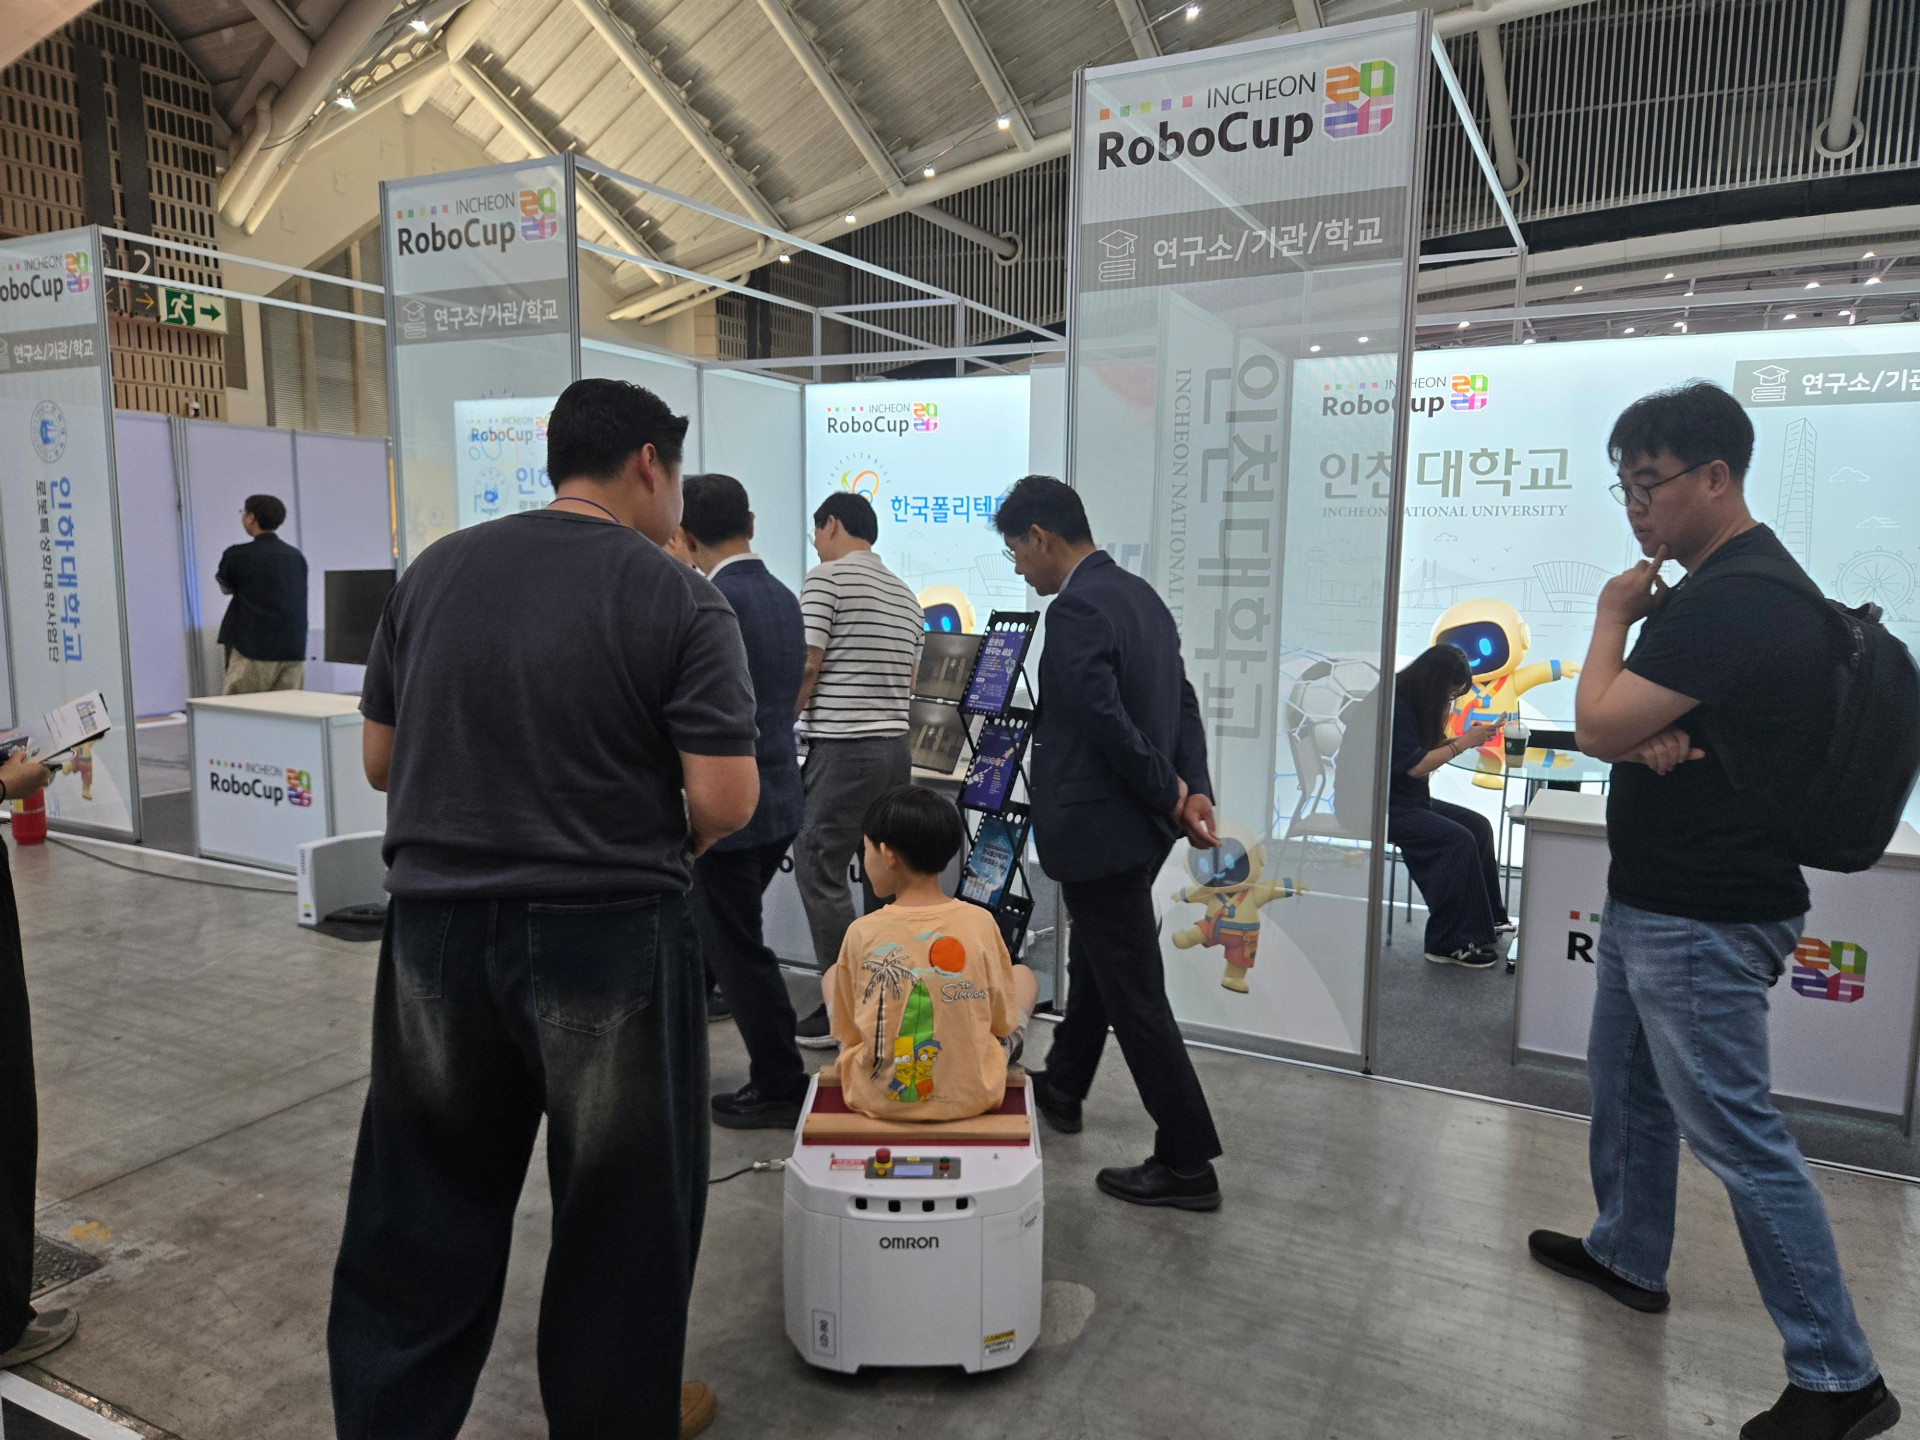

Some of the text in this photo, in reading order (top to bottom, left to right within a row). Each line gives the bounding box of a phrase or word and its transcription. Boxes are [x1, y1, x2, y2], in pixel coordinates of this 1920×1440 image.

[1207, 71, 1316, 109] INCHEON
[1098, 110, 1314, 171] RoboCup
[456, 192, 515, 215] INCHEON
[398, 218, 516, 256] RoboCup
[1153, 216, 1383, 270] 연구소/기관/학교
[24, 255, 62, 271] INCHEON
[0, 275, 64, 301] oboCup
[434, 299, 559, 331] 연구소/기관/학교
[13, 338, 94, 365] 연구소/기관/학교
[1385, 376, 1447, 391] INHEON
[869, 403, 910, 413] INCHEON
[1322, 394, 1445, 418] Roboup
[470, 427, 533, 445] RoboCup
[827, 416, 910, 437] RoboCup
[1172, 367, 1192, 477] INCHEON
[891, 495, 1004, 524] 한국폴리텍
[1323, 505, 1568, 518] INCHEON ATIONAL UNIVERSITY
[1168, 482, 1188, 599] NATIONAL
[1195, 354, 1280, 739] 인천대학교
[50, 477, 83, 663] 인하대학교
[245, 762, 282, 776] INCHEON
[210, 772, 283, 806] RoboCup
